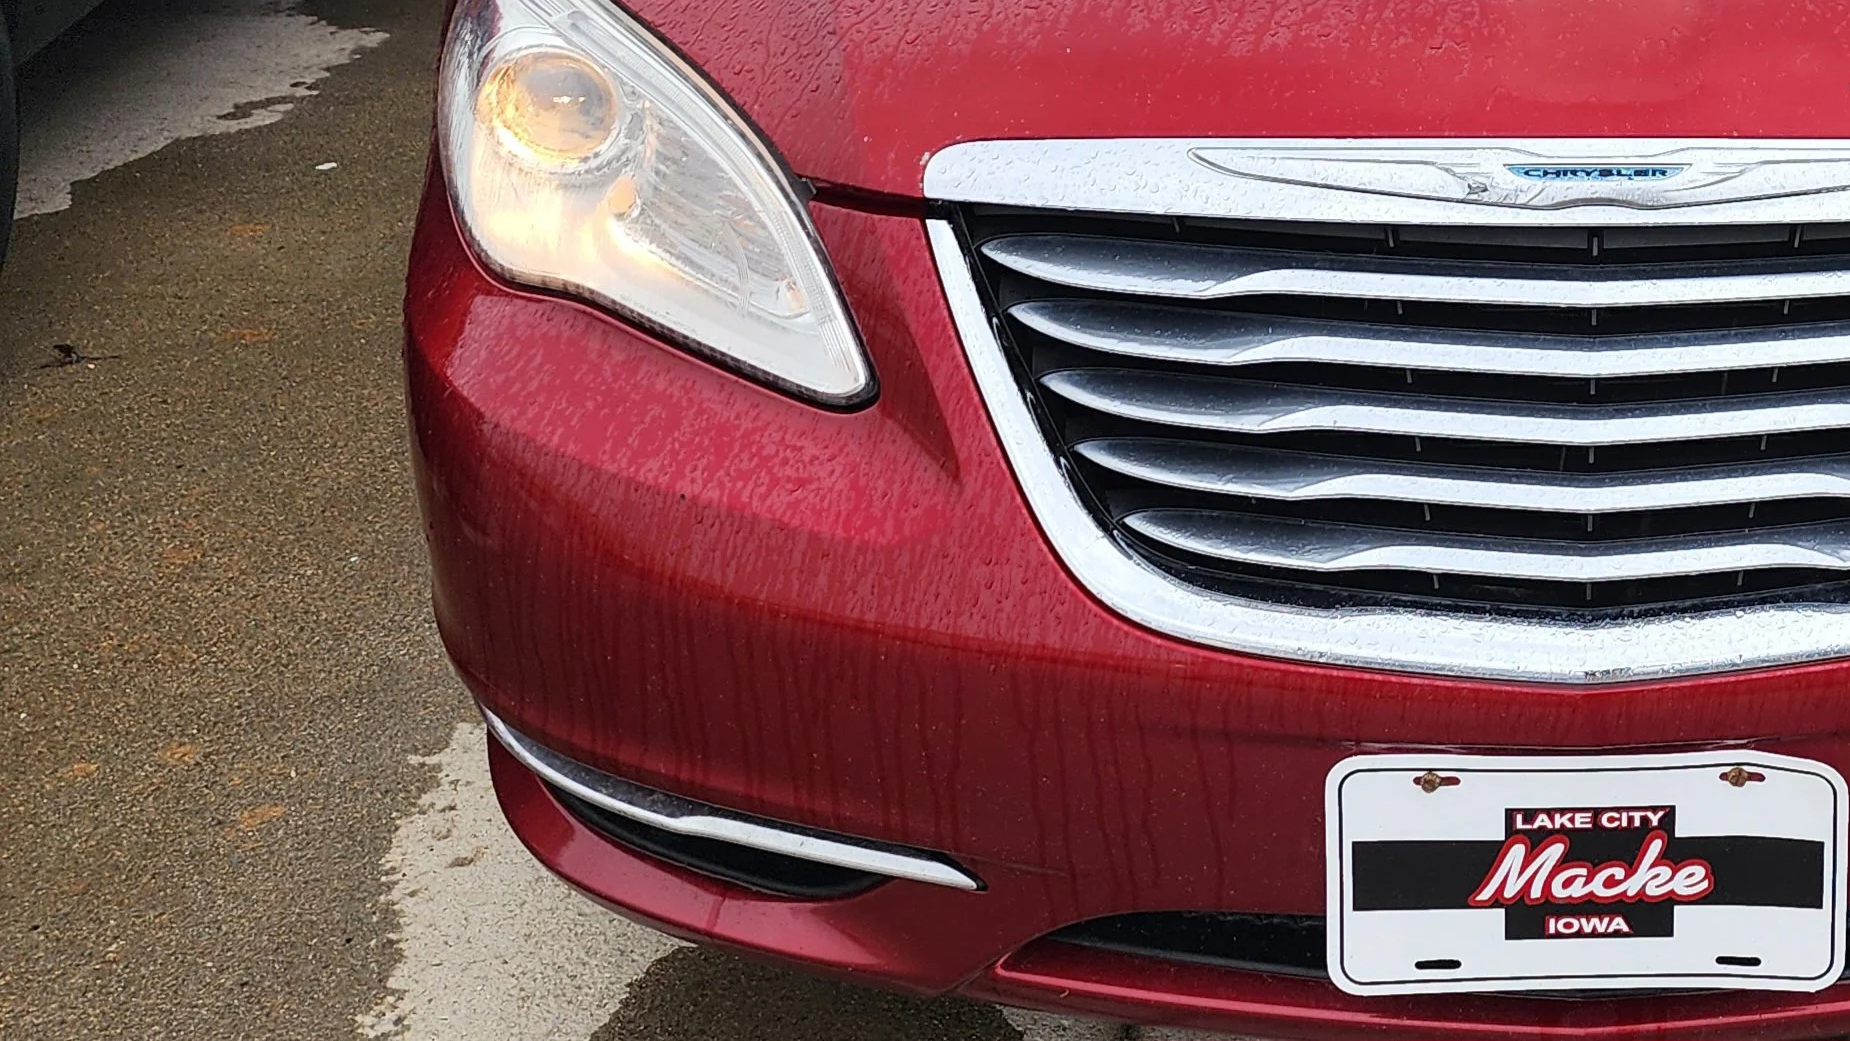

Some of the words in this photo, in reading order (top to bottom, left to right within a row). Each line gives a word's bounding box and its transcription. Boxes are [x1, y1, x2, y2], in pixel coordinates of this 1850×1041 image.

[1523, 168, 1668, 177] CHRYSLER
[1515, 812, 1593, 830] LAKE
[1601, 810, 1667, 828] CITY
[1473, 834, 1710, 902] Macke
[1548, 916, 1631, 934] IOWA
